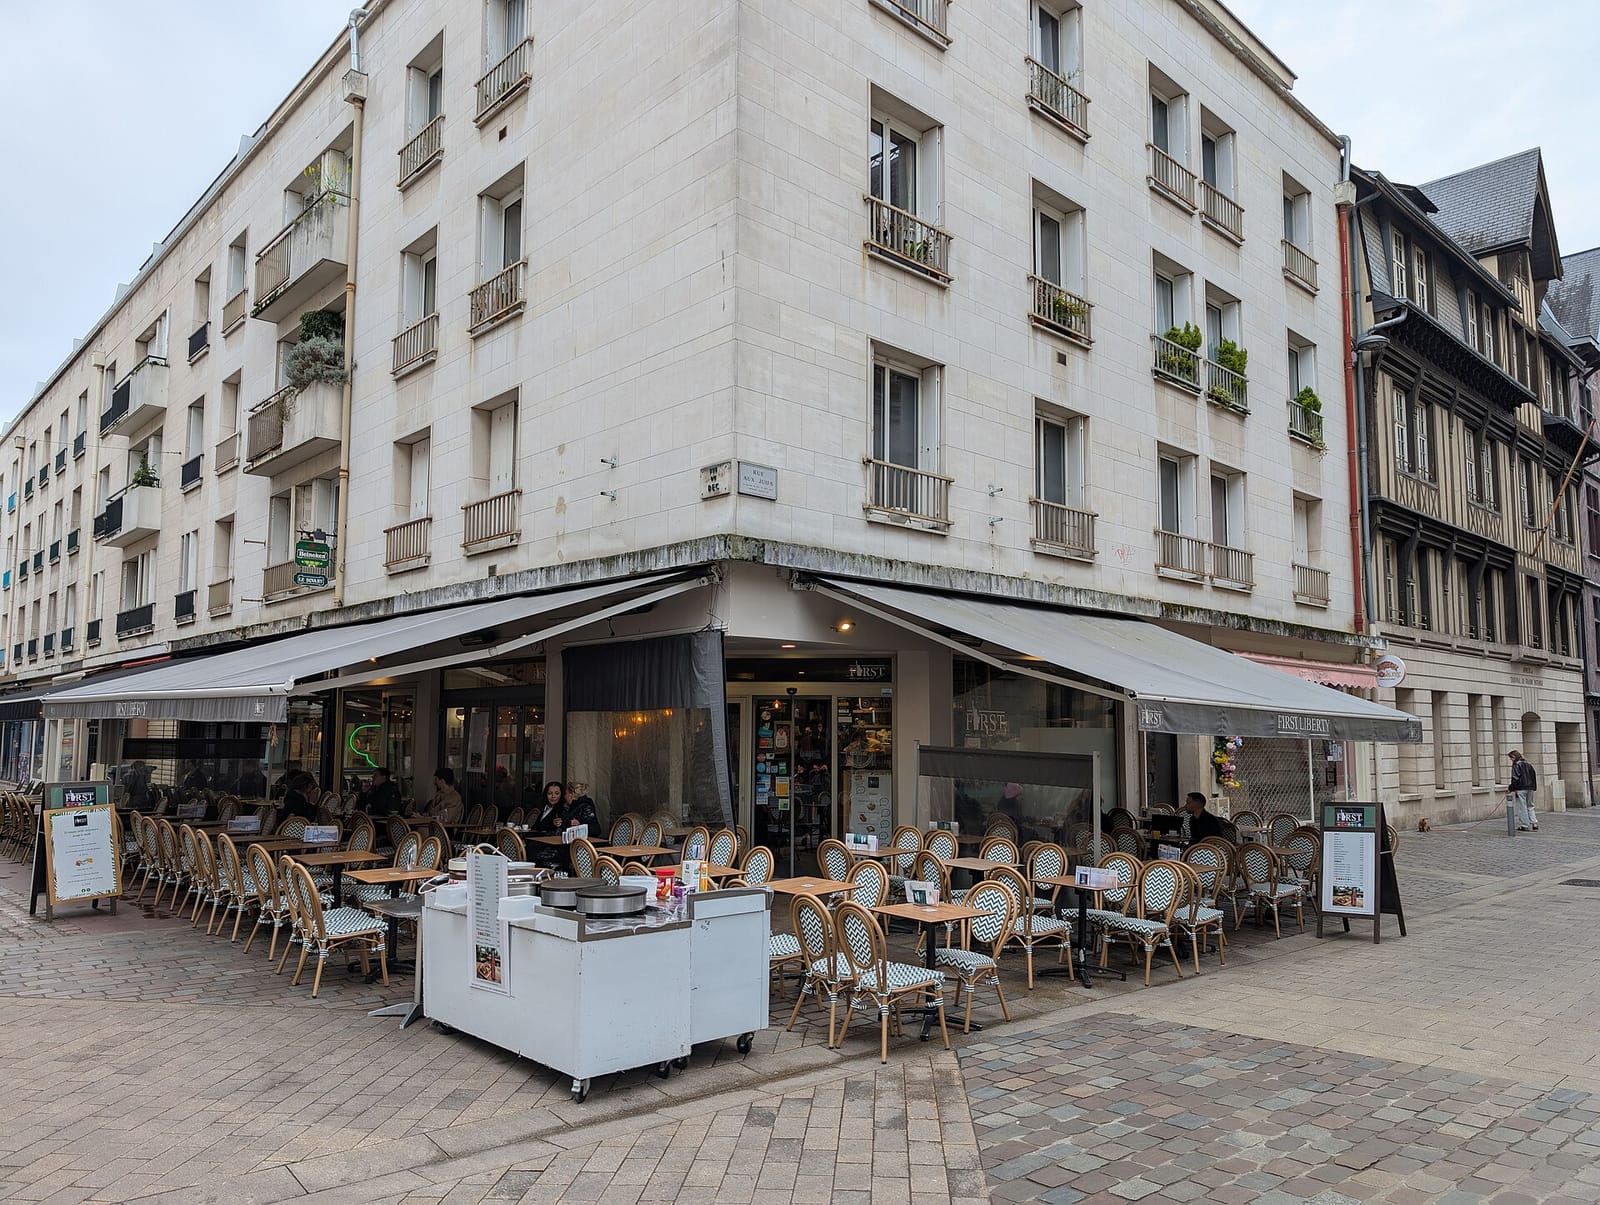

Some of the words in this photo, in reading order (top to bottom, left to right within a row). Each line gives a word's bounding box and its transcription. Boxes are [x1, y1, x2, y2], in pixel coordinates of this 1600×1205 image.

[299, 551, 326, 559] Heineken
[1277, 714, 1298, 730] FIRST
[1299, 716, 1331, 732] LIBERTY
[65, 790, 95, 802] FIRST
[1336, 810, 1363, 822] FIRST
